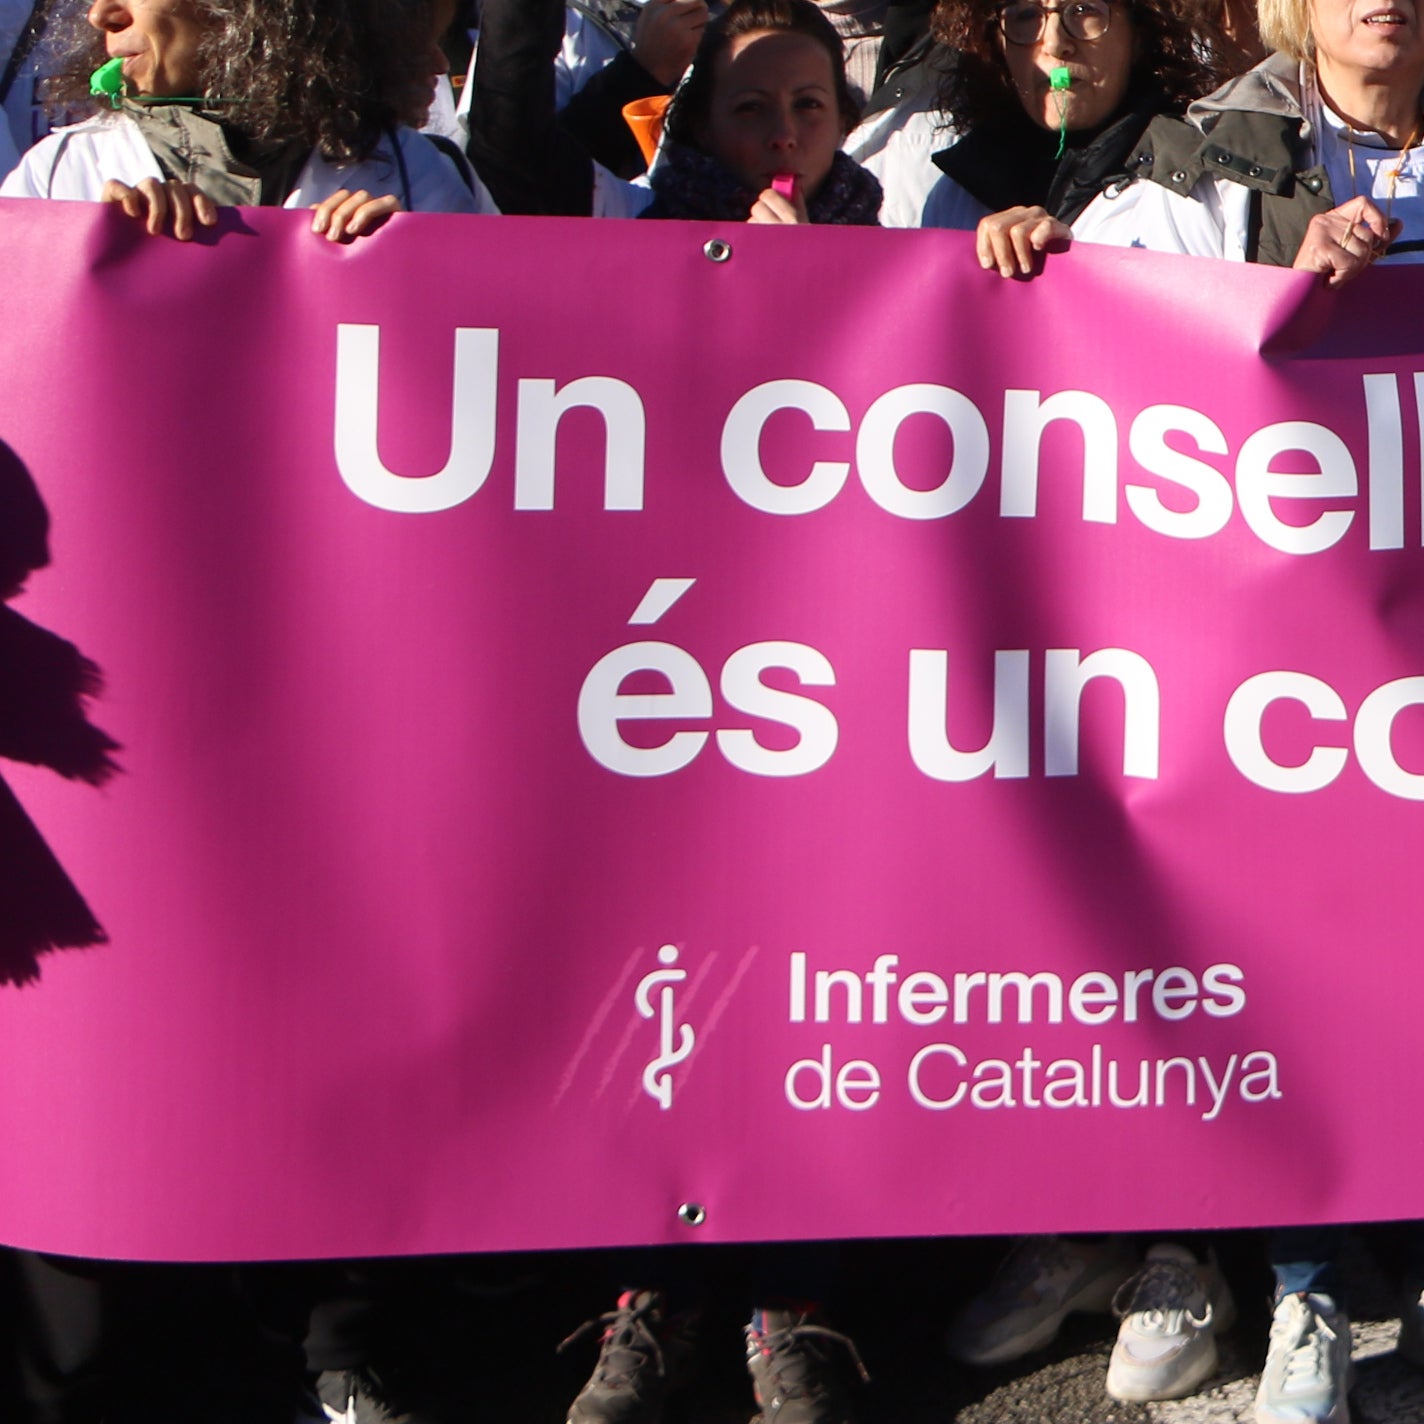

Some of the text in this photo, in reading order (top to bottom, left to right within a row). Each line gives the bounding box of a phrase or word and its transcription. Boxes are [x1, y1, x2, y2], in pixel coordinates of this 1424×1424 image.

[334, 324, 646, 513] Un
[577, 578, 838, 777] és
[908, 647, 1160, 782] un
[790, 952, 1245, 1024] Infermeres
[785, 1042, 1282, 1120] de Catalunya
